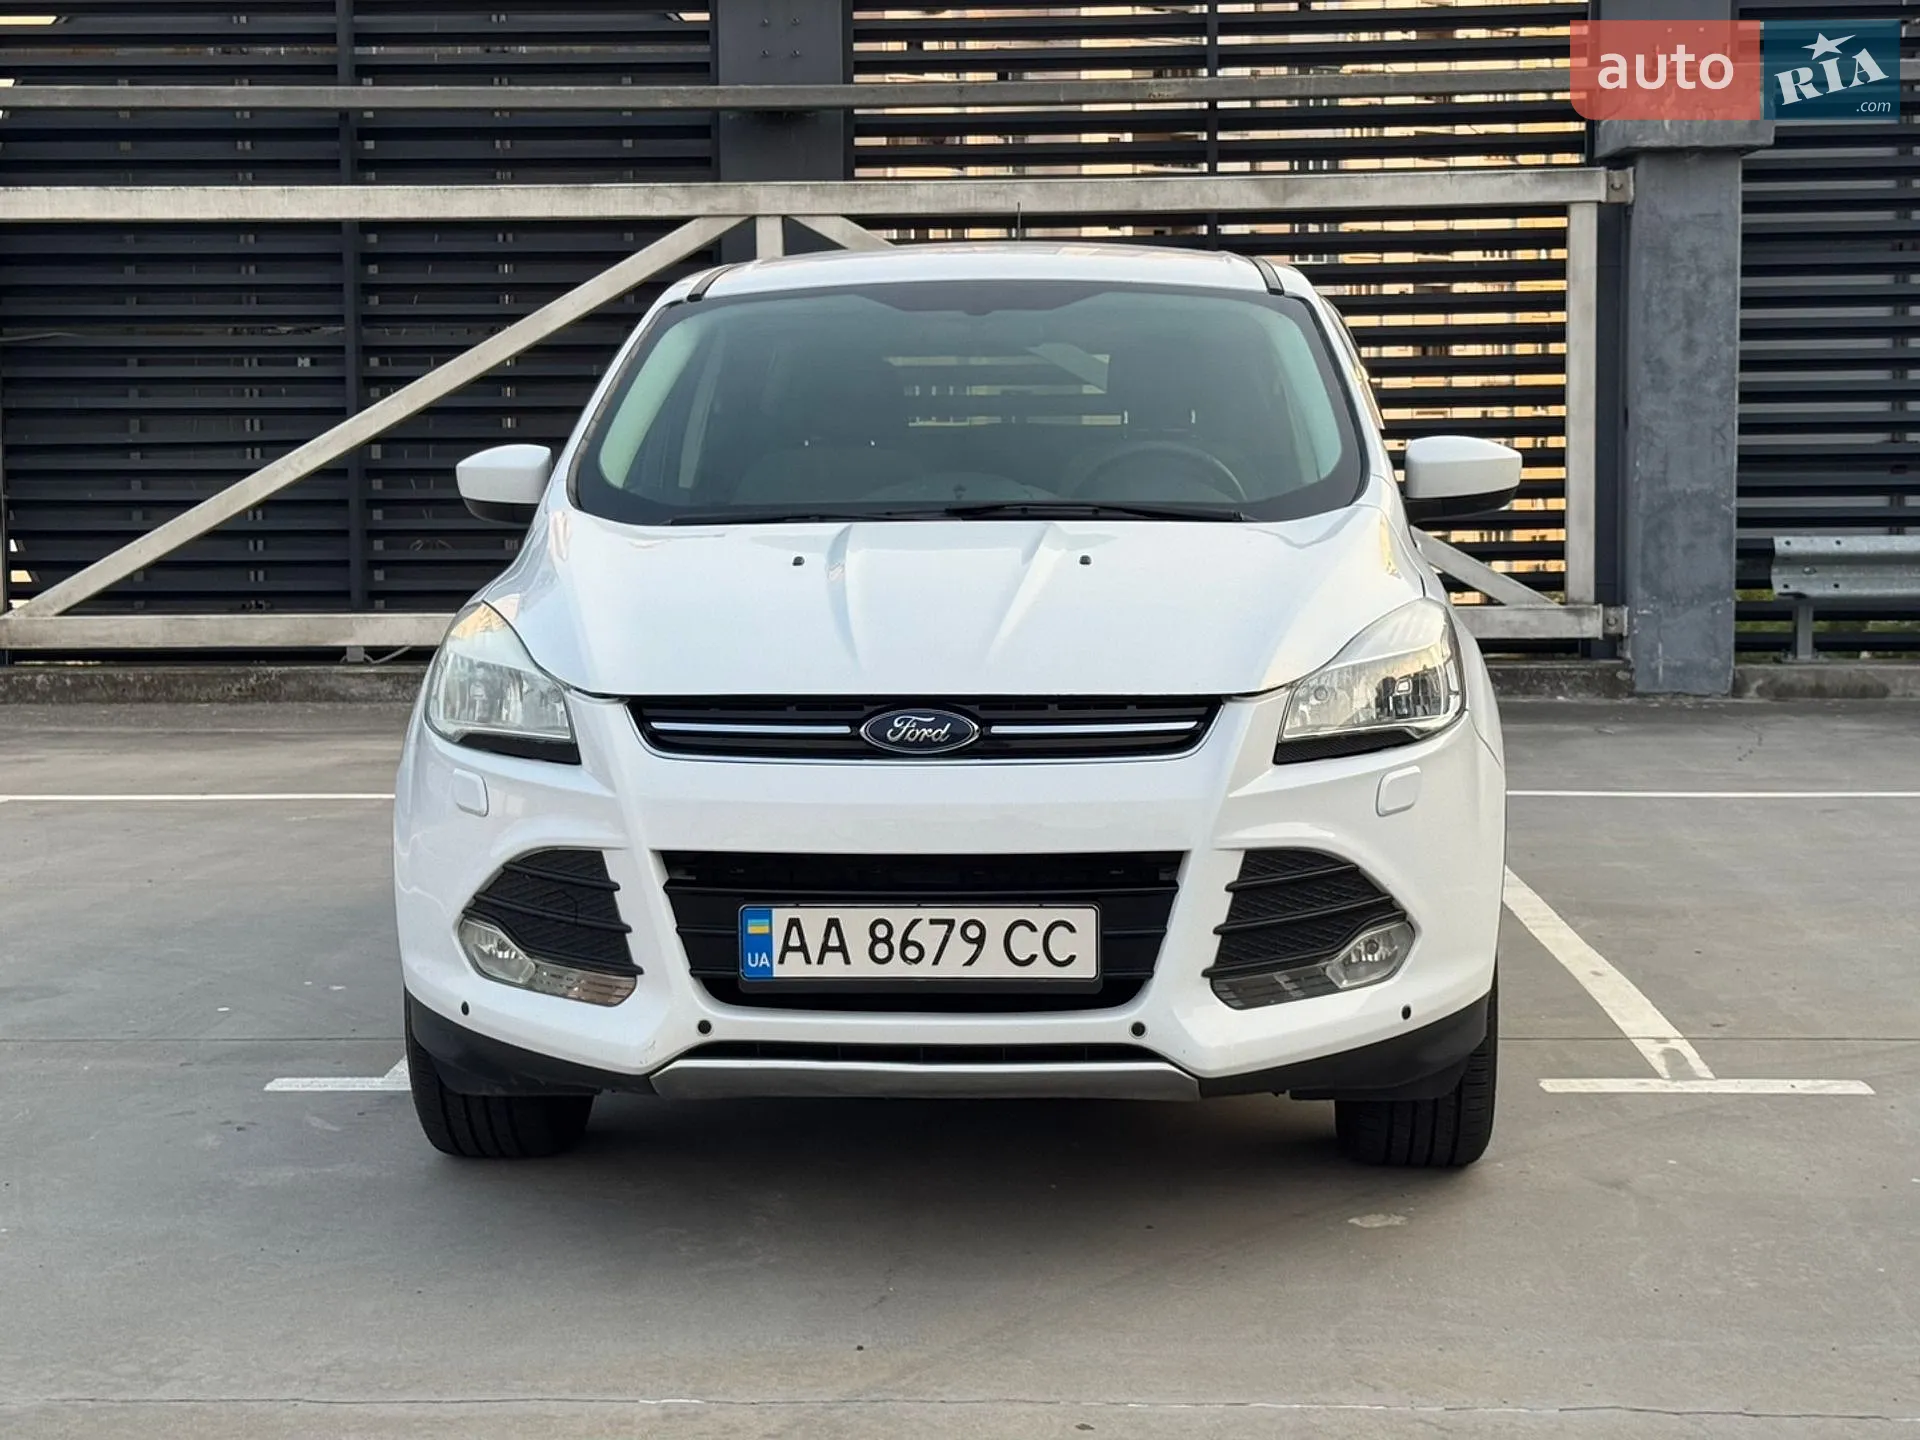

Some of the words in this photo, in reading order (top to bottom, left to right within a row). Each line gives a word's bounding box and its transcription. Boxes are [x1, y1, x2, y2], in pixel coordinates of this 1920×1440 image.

[886, 715, 952, 742] Ford
[777, 917, 852, 966] AA
[867, 917, 987, 967] 8679
[1002, 919, 1078, 968] CC
[747, 952, 771, 968] UA
